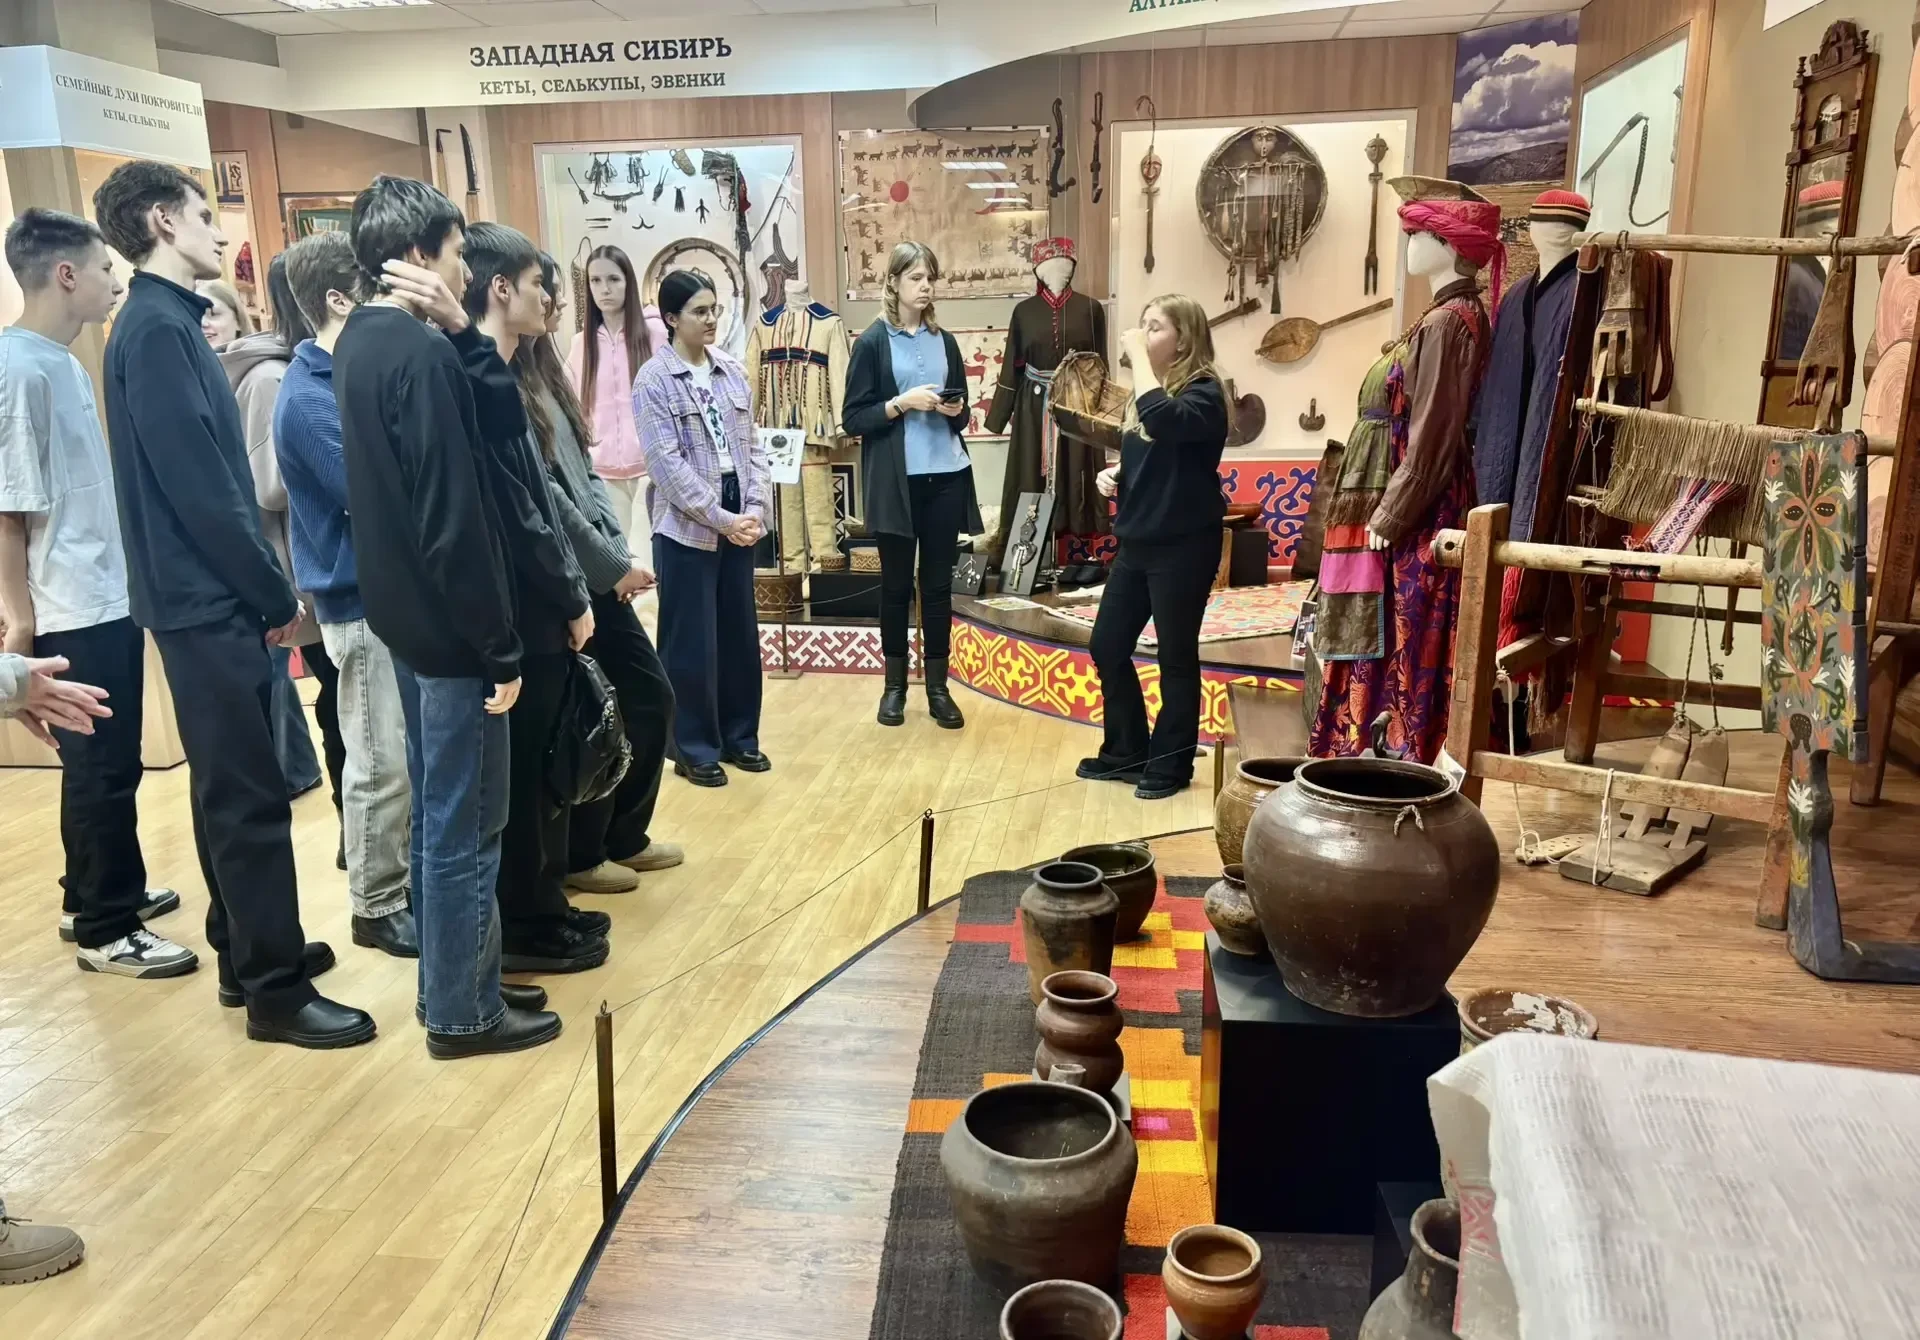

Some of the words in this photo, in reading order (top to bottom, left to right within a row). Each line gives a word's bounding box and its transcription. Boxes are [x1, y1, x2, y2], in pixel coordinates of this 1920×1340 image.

[470, 42, 615, 68] ЗАПАДНАЯ
[623, 37, 732, 61] СИБИРЬ
[55, 74, 114, 98] СЕМЕЙНЫЕ
[114, 87, 140, 103] ДУХИ
[141, 93, 203, 117] ПОКРОВИТЕЛИ
[480, 80, 536, 97] КЕТЫ,
[541, 76, 646, 93] СЕЛЬКУПЫ,
[651, 72, 726, 89] ЭВЕНКИ
[103, 108, 128, 123] КЕТЫ,
[128, 113, 171, 131] СЕЛЬКУПЫ
